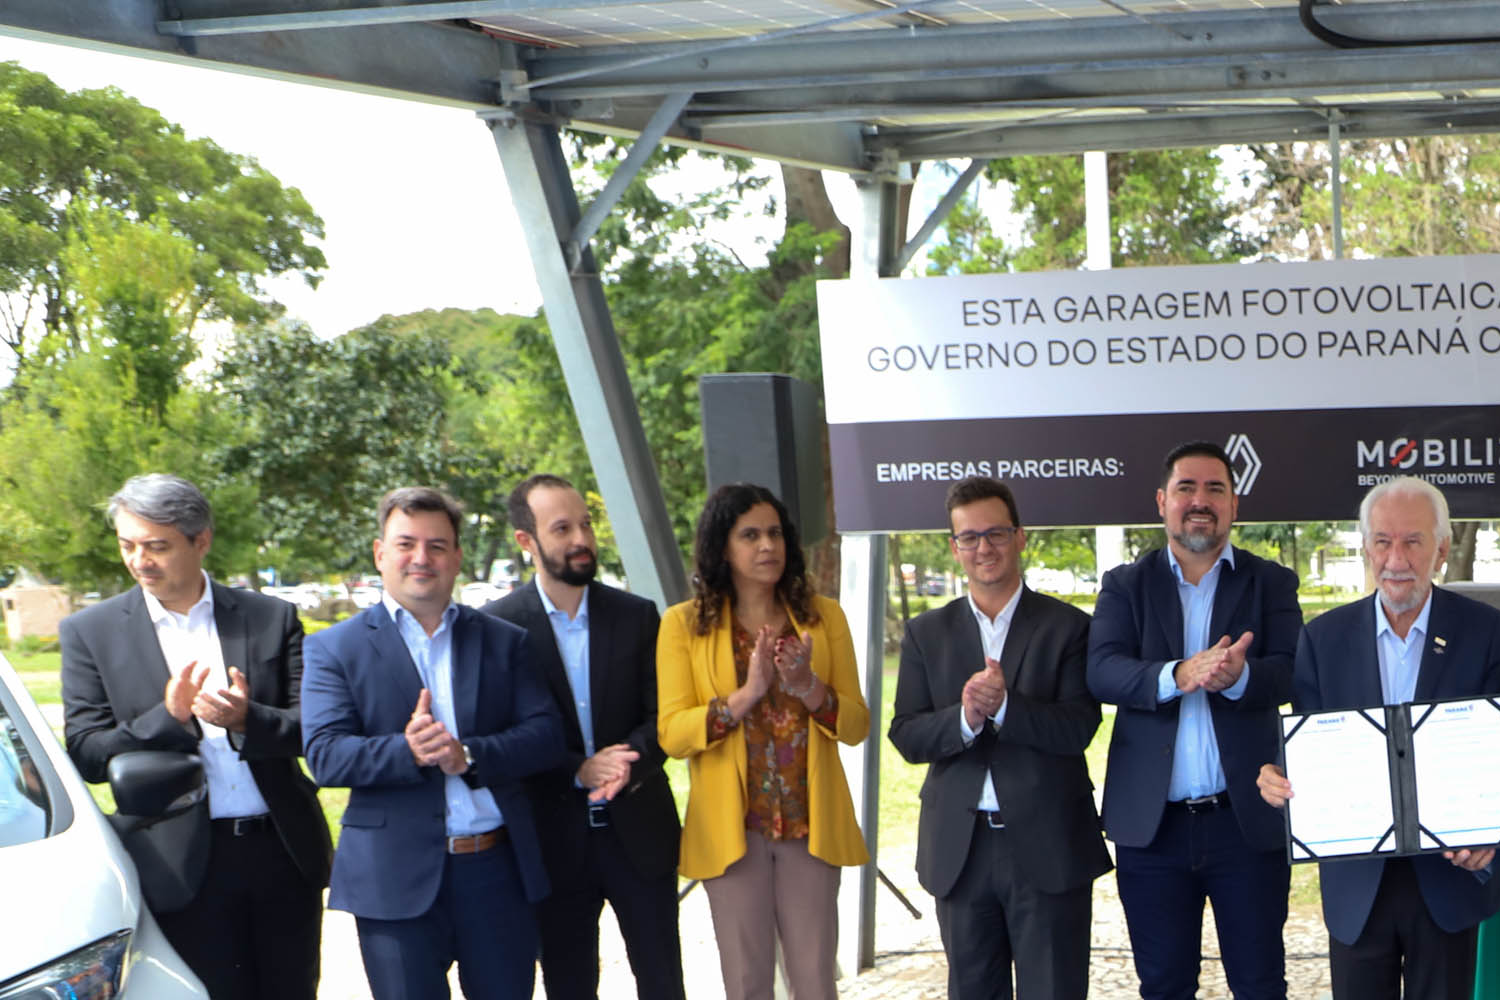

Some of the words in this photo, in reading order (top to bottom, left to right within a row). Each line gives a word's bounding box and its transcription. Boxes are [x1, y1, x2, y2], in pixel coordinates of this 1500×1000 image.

[963, 298, 1045, 326] ESTA
[1054, 291, 1231, 323] GARAGEM
[868, 341, 1037, 372] GOVERNO
[1048, 339, 1097, 366] DO
[1107, 334, 1245, 364] ESTADO
[1256, 332, 1307, 360] DO
[1318, 316, 1470, 358] PARANÁ
[877, 461, 992, 482] EMPRESAS
[997, 458, 1124, 478] PARCEIRAS:
[1358, 473, 1408, 486] BEYO
